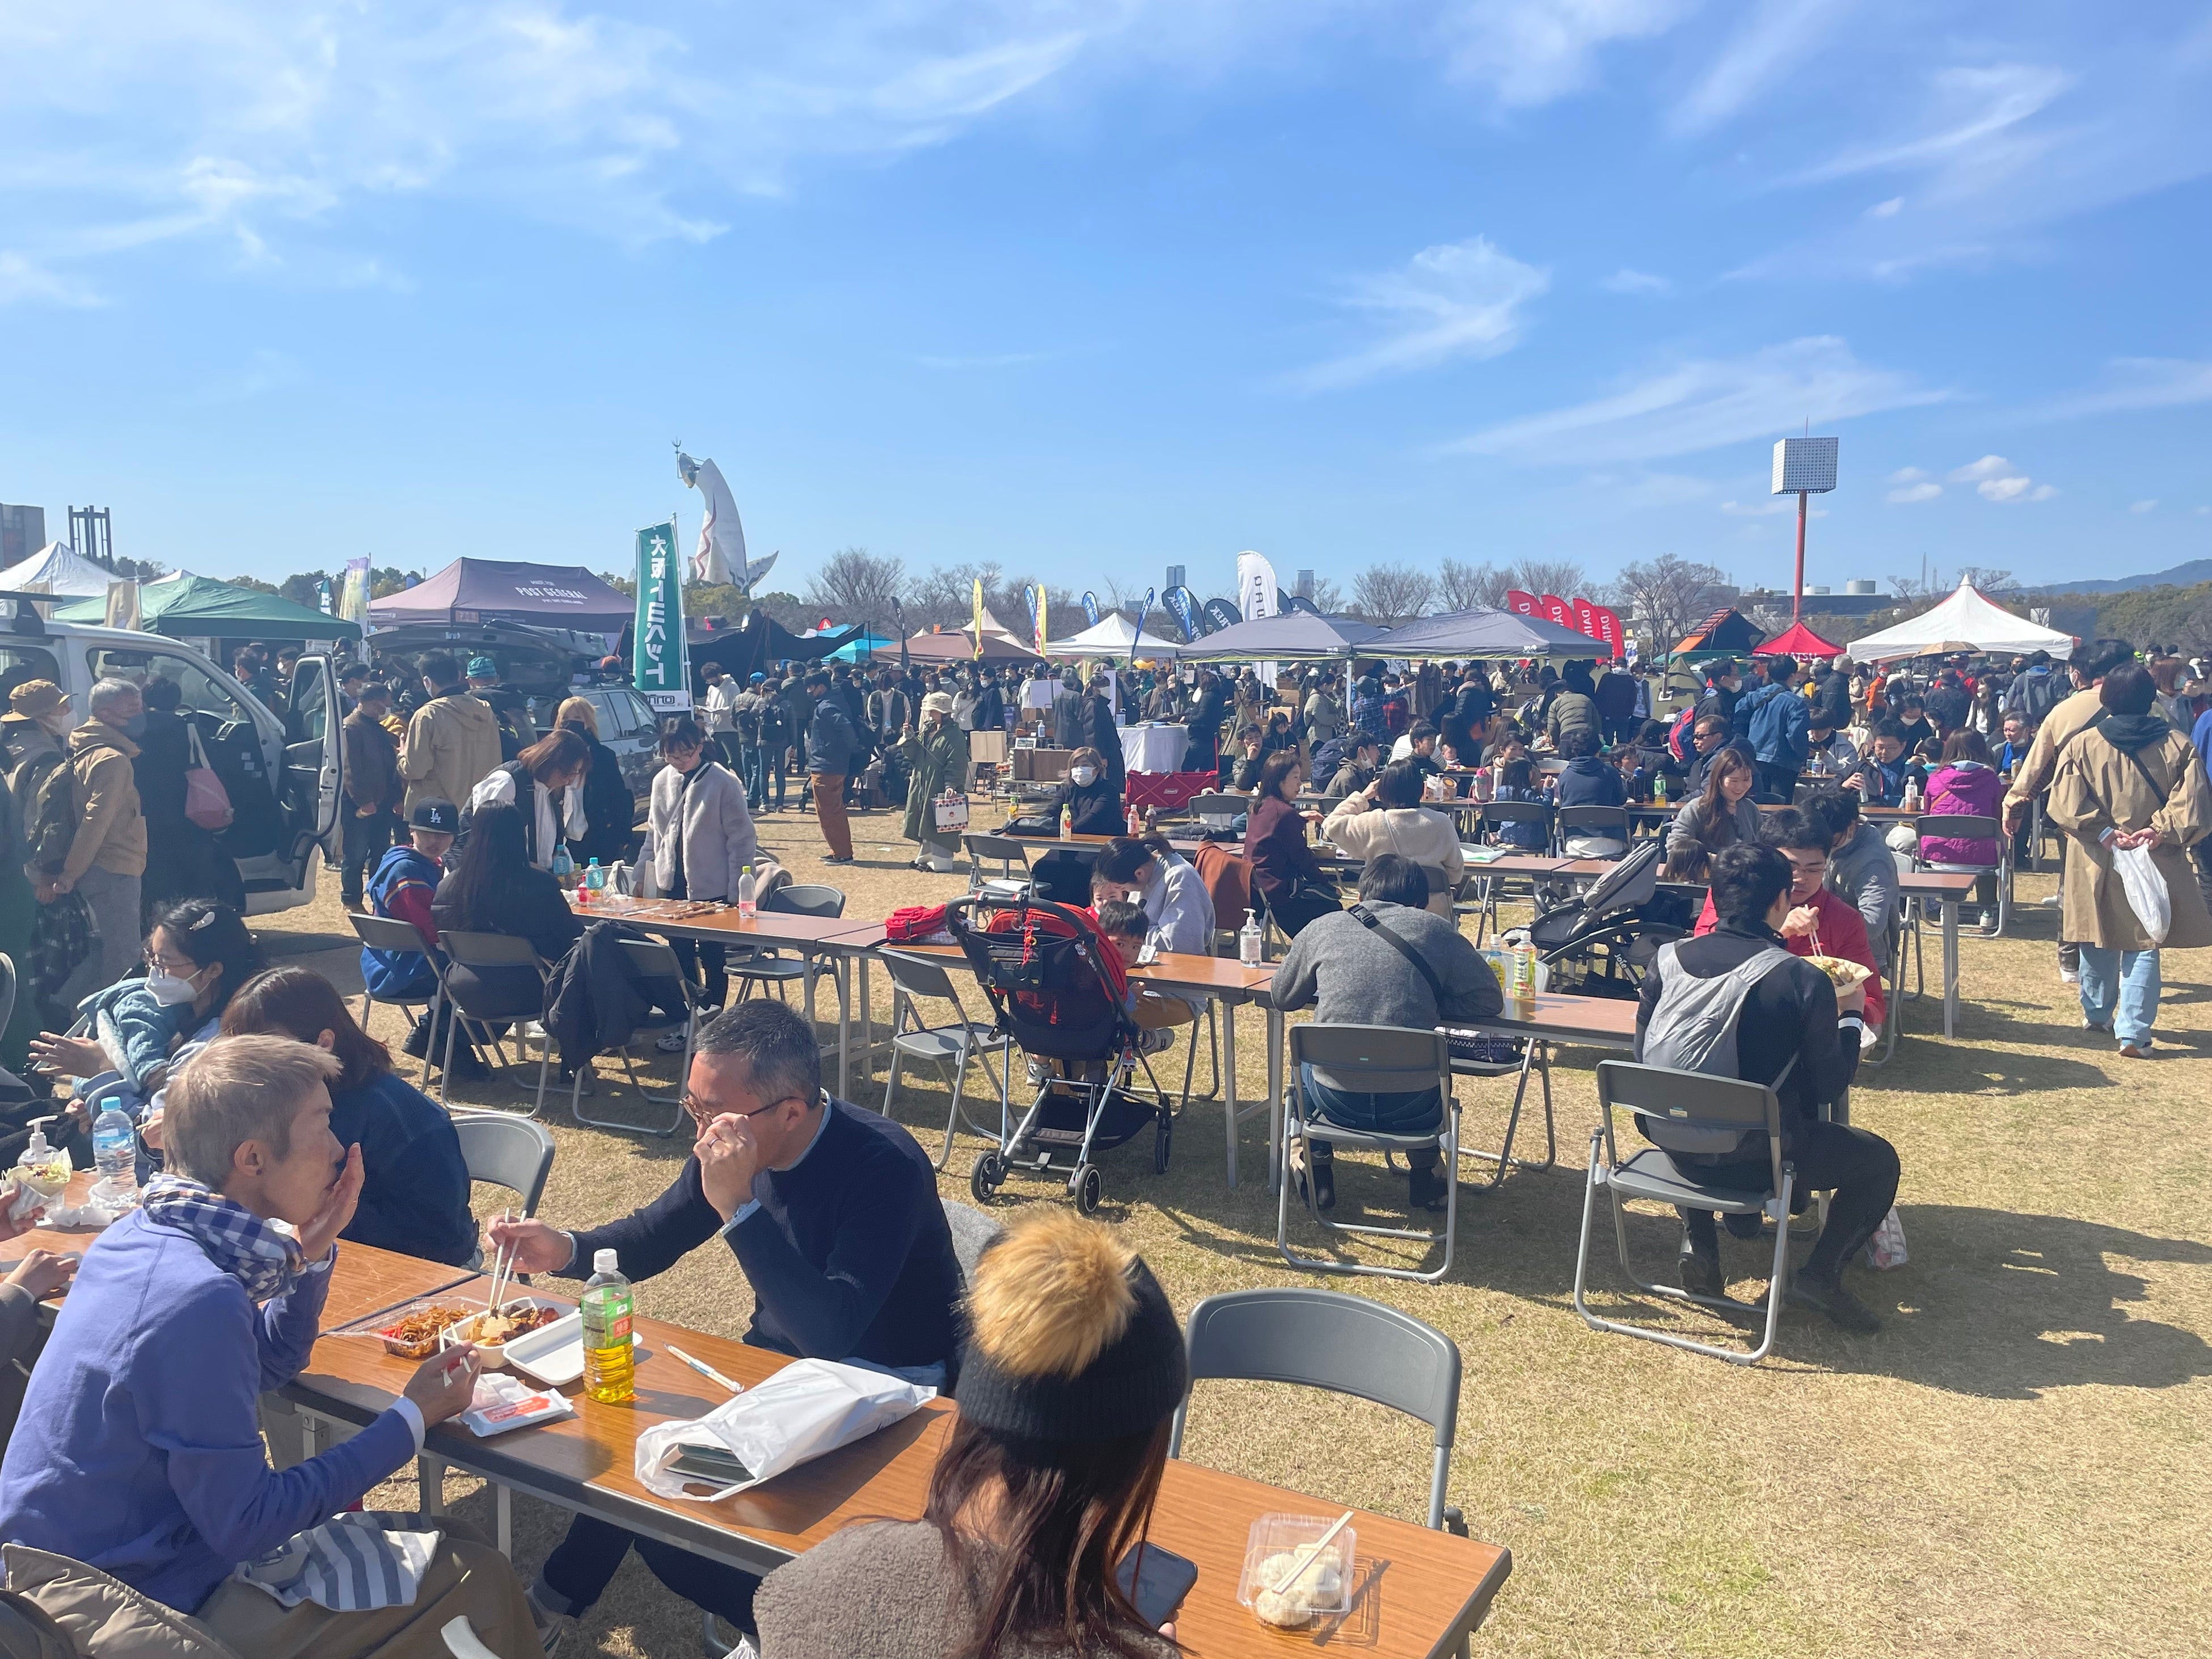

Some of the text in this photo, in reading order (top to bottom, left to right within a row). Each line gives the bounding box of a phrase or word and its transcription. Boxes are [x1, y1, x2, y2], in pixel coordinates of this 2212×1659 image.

[514, 587, 588, 600] POST GENERAL
[430, 808, 442, 824] LA
[1614, 953, 1628, 969] Joie
